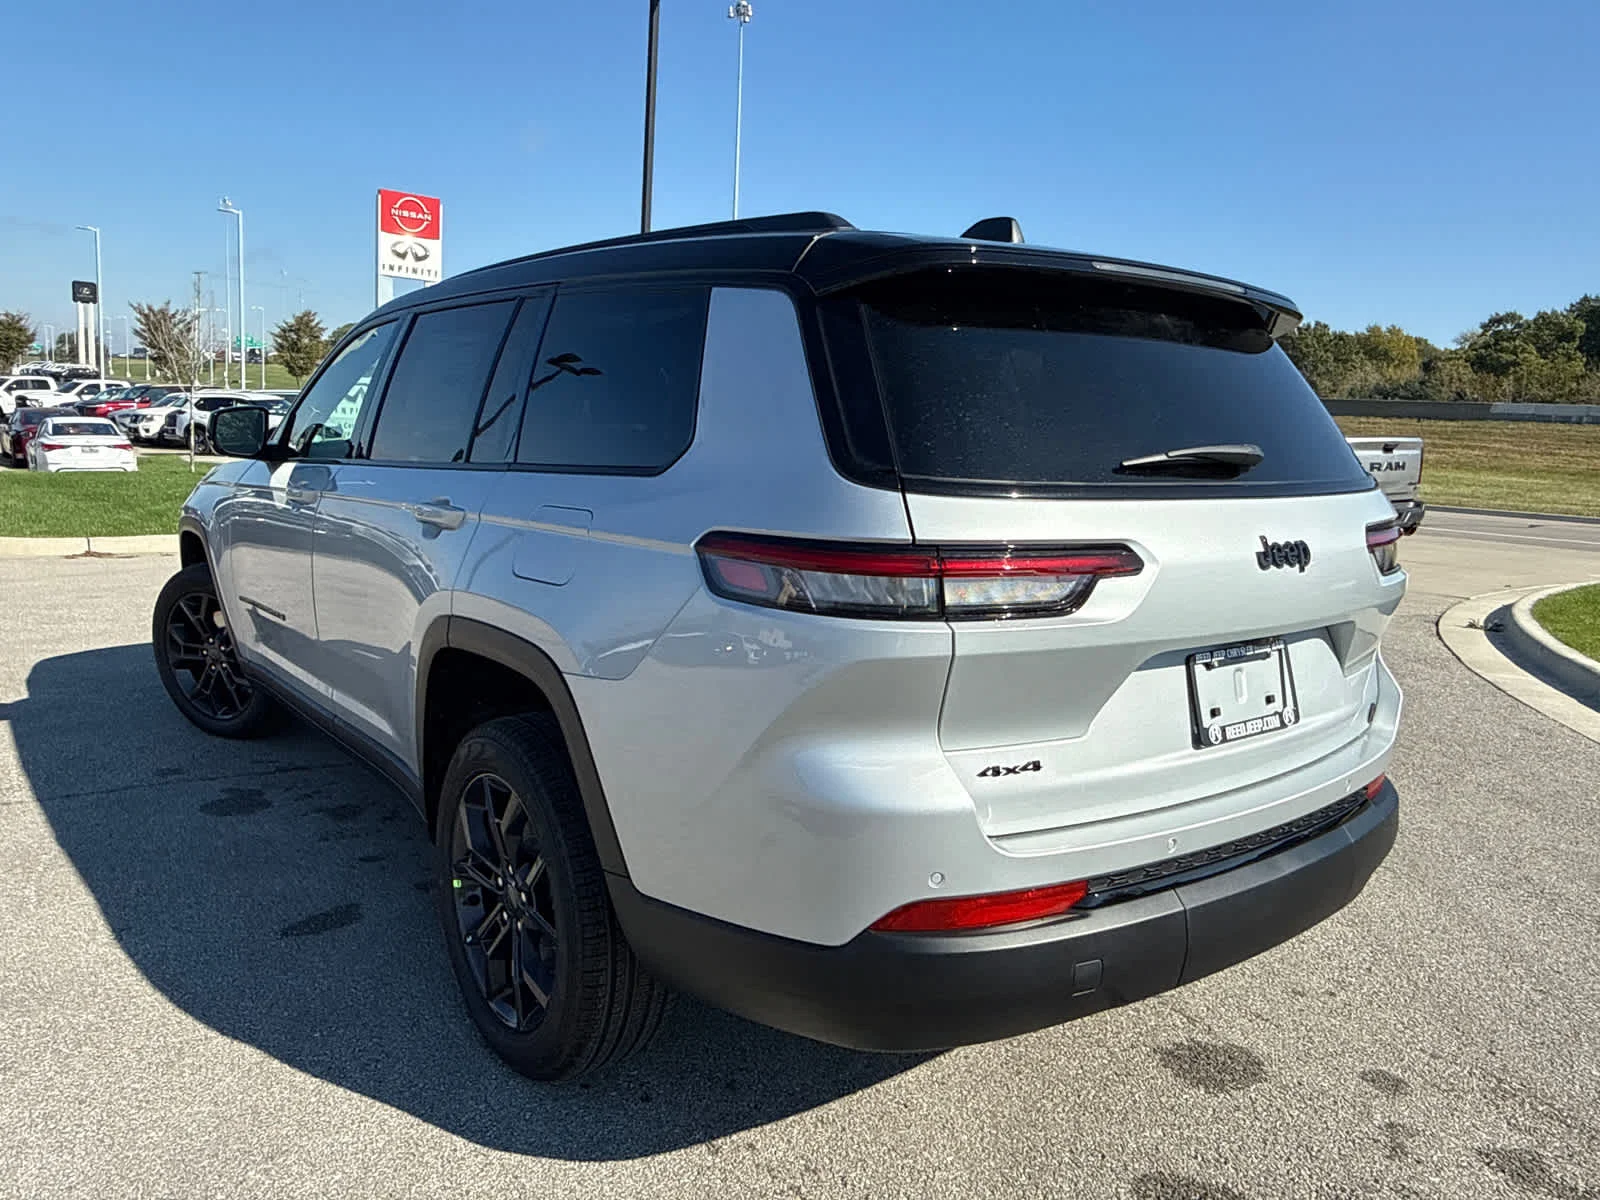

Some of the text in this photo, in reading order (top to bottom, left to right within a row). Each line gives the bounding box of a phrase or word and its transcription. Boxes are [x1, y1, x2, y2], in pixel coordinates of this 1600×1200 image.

[391, 208, 432, 221] NISSAN
[382, 263, 438, 278] INFINITI
[1369, 461, 1406, 472] RAM
[1255, 535, 1311, 573] Jeep
[976, 760, 1043, 777] 4x4
